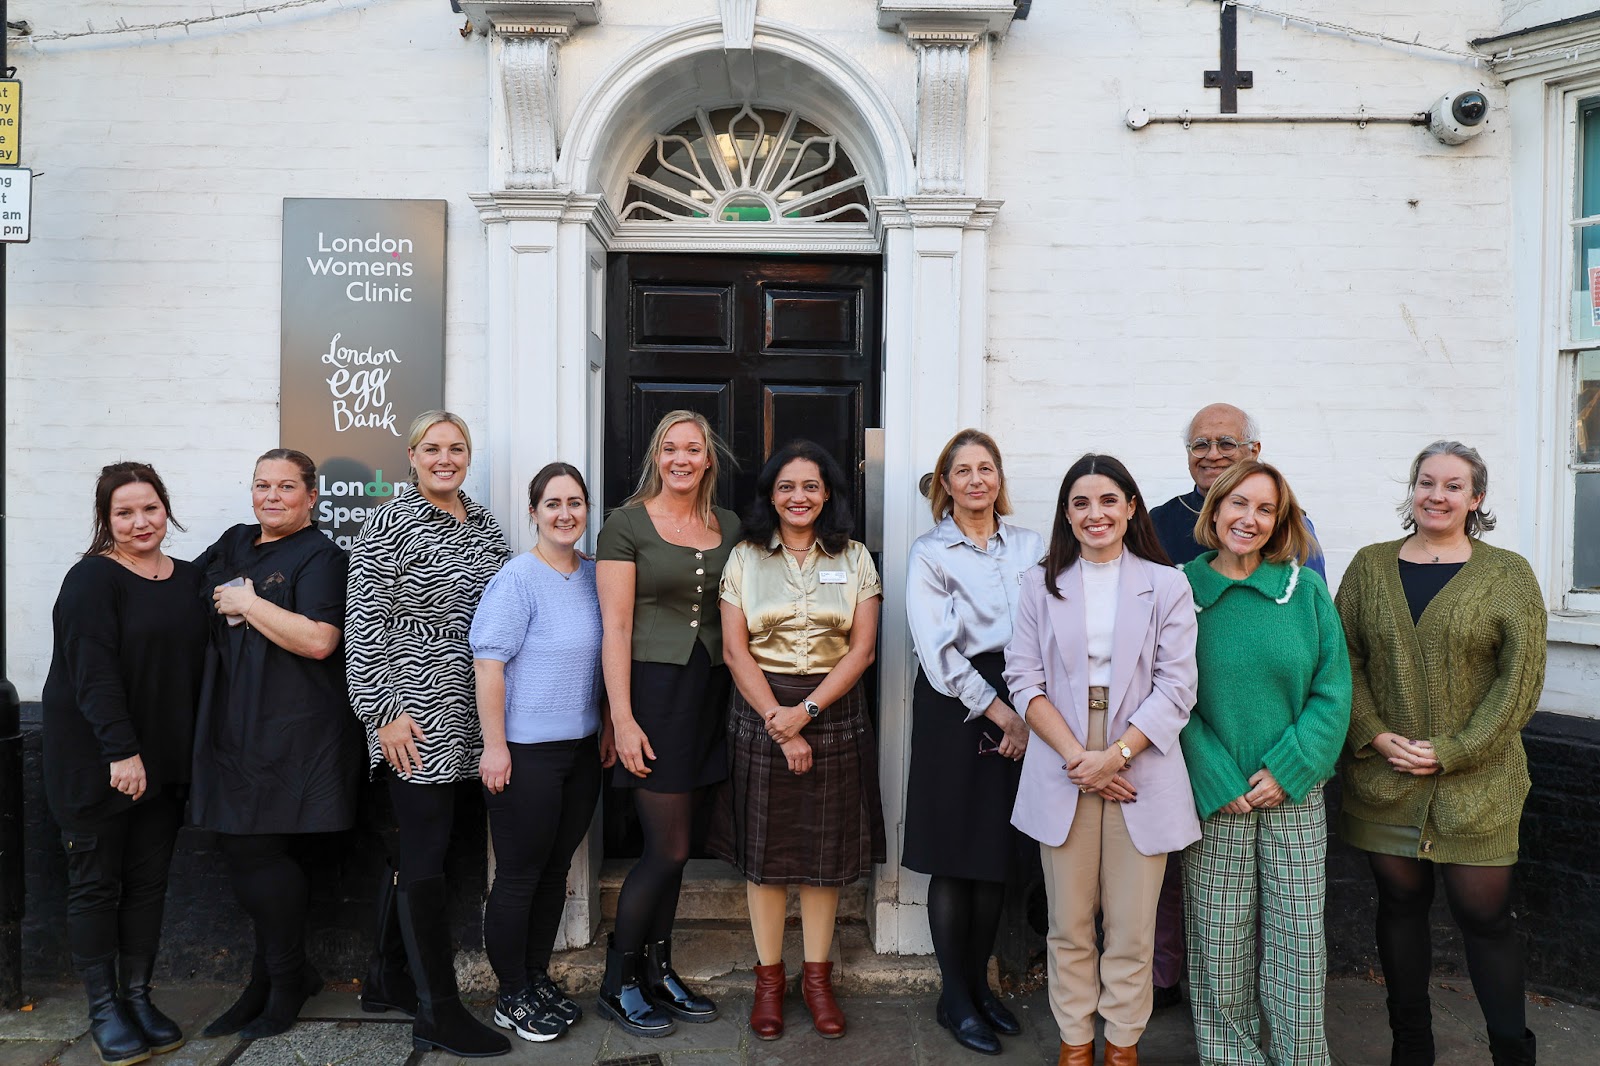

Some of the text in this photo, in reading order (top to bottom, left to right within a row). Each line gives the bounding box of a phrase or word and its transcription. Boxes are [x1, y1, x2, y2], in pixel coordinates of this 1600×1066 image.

[2, 211, 21, 220] am
[3, 225, 23, 236] pm
[318, 232, 413, 253] London
[346, 281, 412, 302] Clinic
[321, 333, 402, 368] London
[326, 367, 391, 413] egg
[332, 400, 402, 437] Bank
[318, 500, 377, 529] Sper
